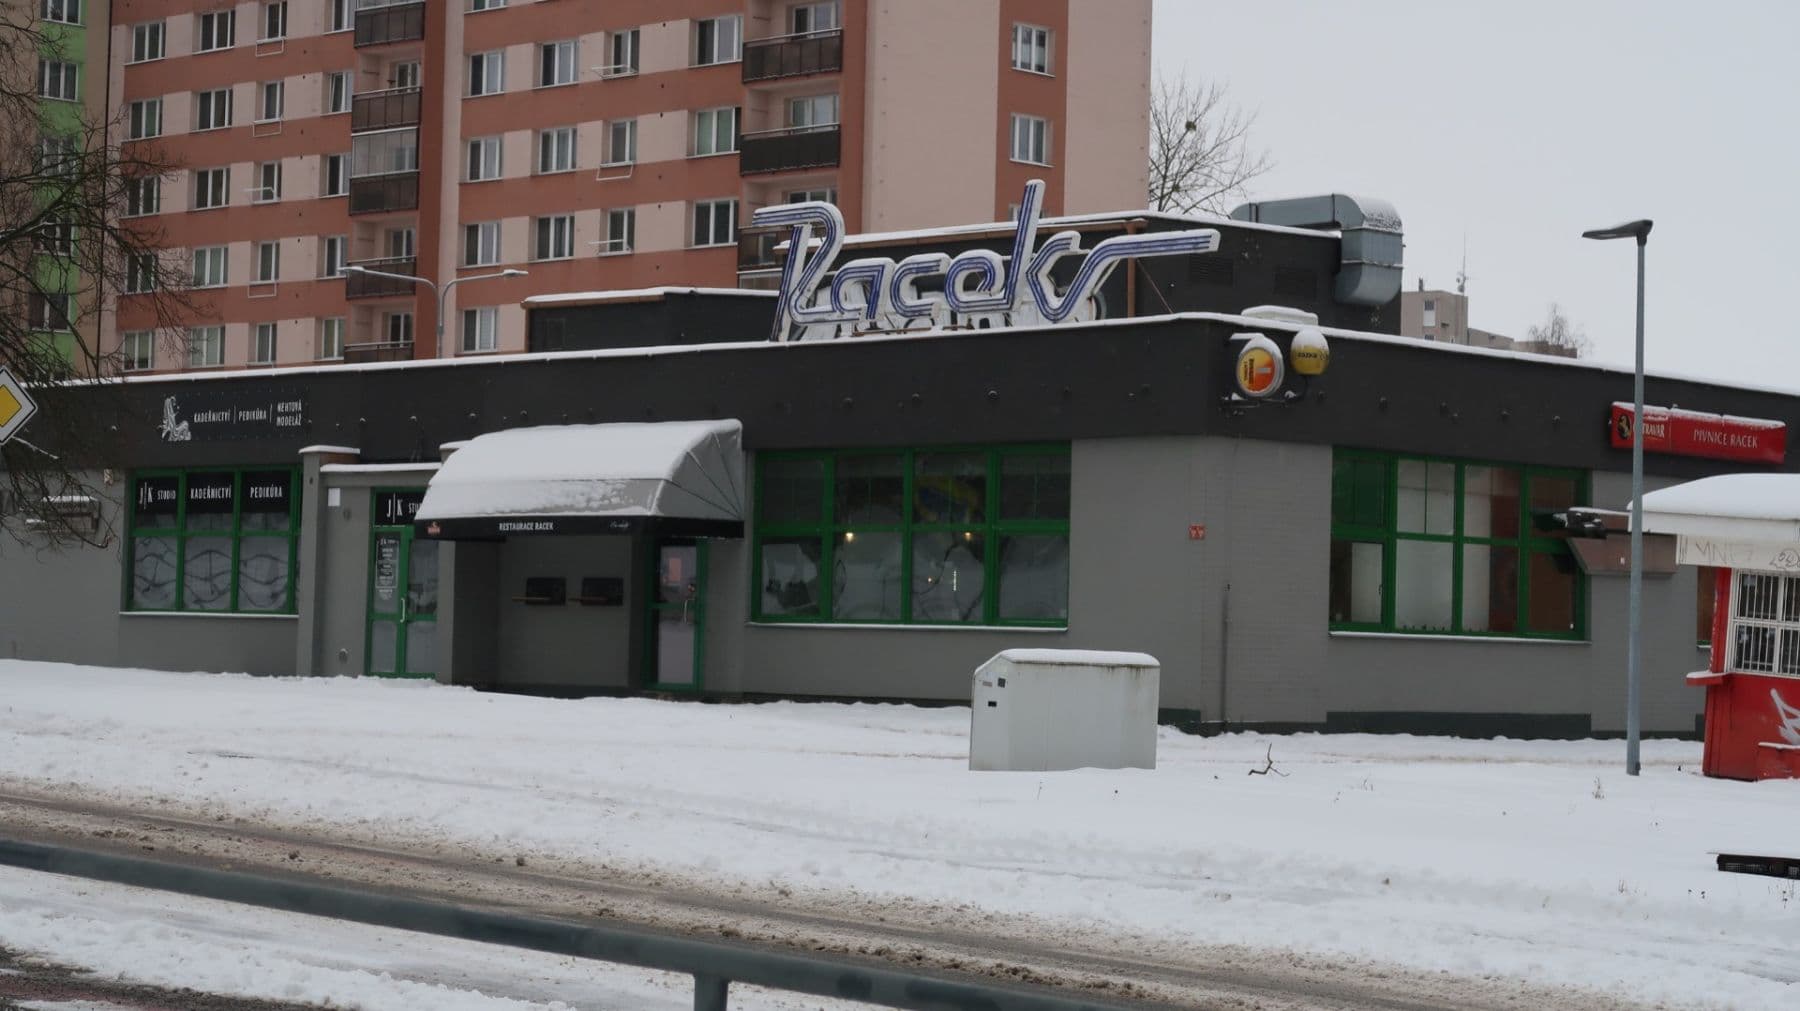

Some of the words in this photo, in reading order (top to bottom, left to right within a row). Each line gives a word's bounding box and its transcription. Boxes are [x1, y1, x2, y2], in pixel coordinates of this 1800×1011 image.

[753, 178, 1221, 343] Racek
[277, 399, 302, 413] NEHTOVÁ
[194, 409, 231, 423] KADEŘNICTVÍ
[1693, 428, 1728, 446] PIVNICE
[1730, 433, 1758, 449] RACEK
[157, 487, 176, 500] STUDIO
[190, 485, 232, 500] KADEŘNICTVÍ
[498, 522, 534, 532] RESTAURACE
[535, 521, 554, 531] RACEK
